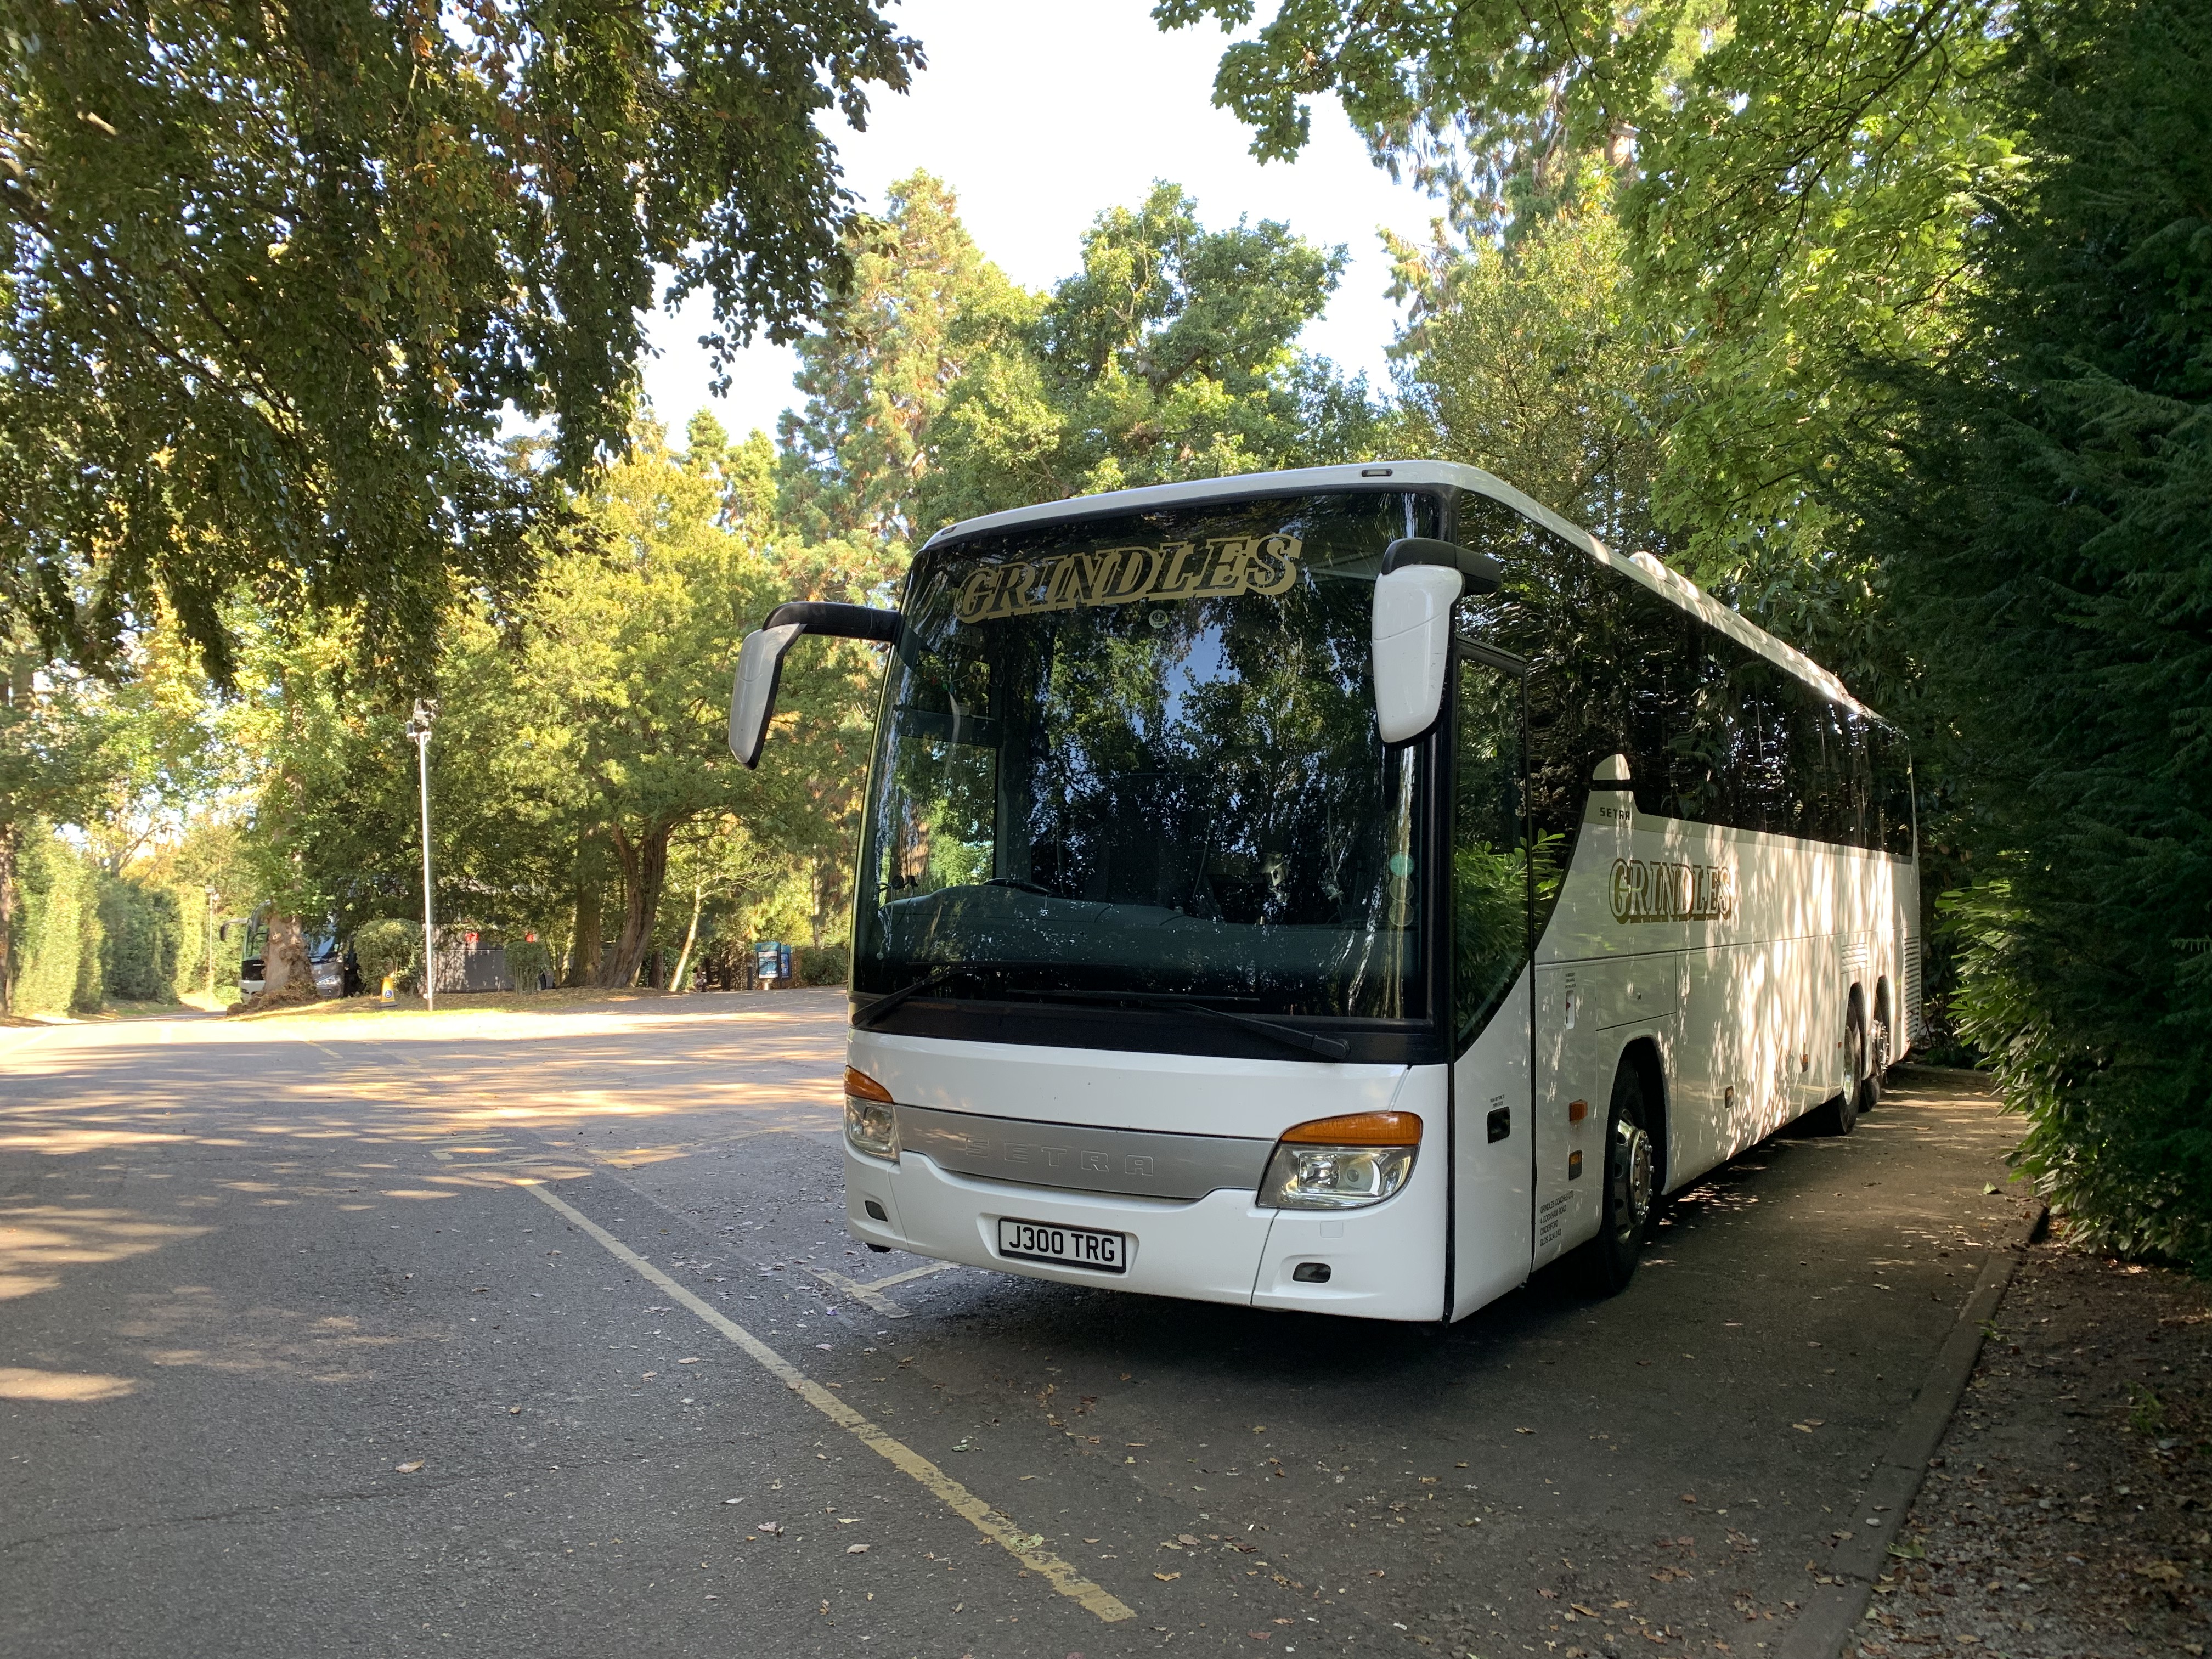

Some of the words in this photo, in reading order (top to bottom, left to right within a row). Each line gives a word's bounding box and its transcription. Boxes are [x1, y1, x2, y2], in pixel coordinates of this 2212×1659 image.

[954, 533, 1302, 624] GRINDLES
[1600, 807, 1630, 820] SETRA
[1609, 858, 1731, 924] GRINDLES
[966, 1137, 1153, 1176] SETRA
[1009, 1226, 1064, 1255] J300
[1071, 1233, 1114, 1262] TRG
